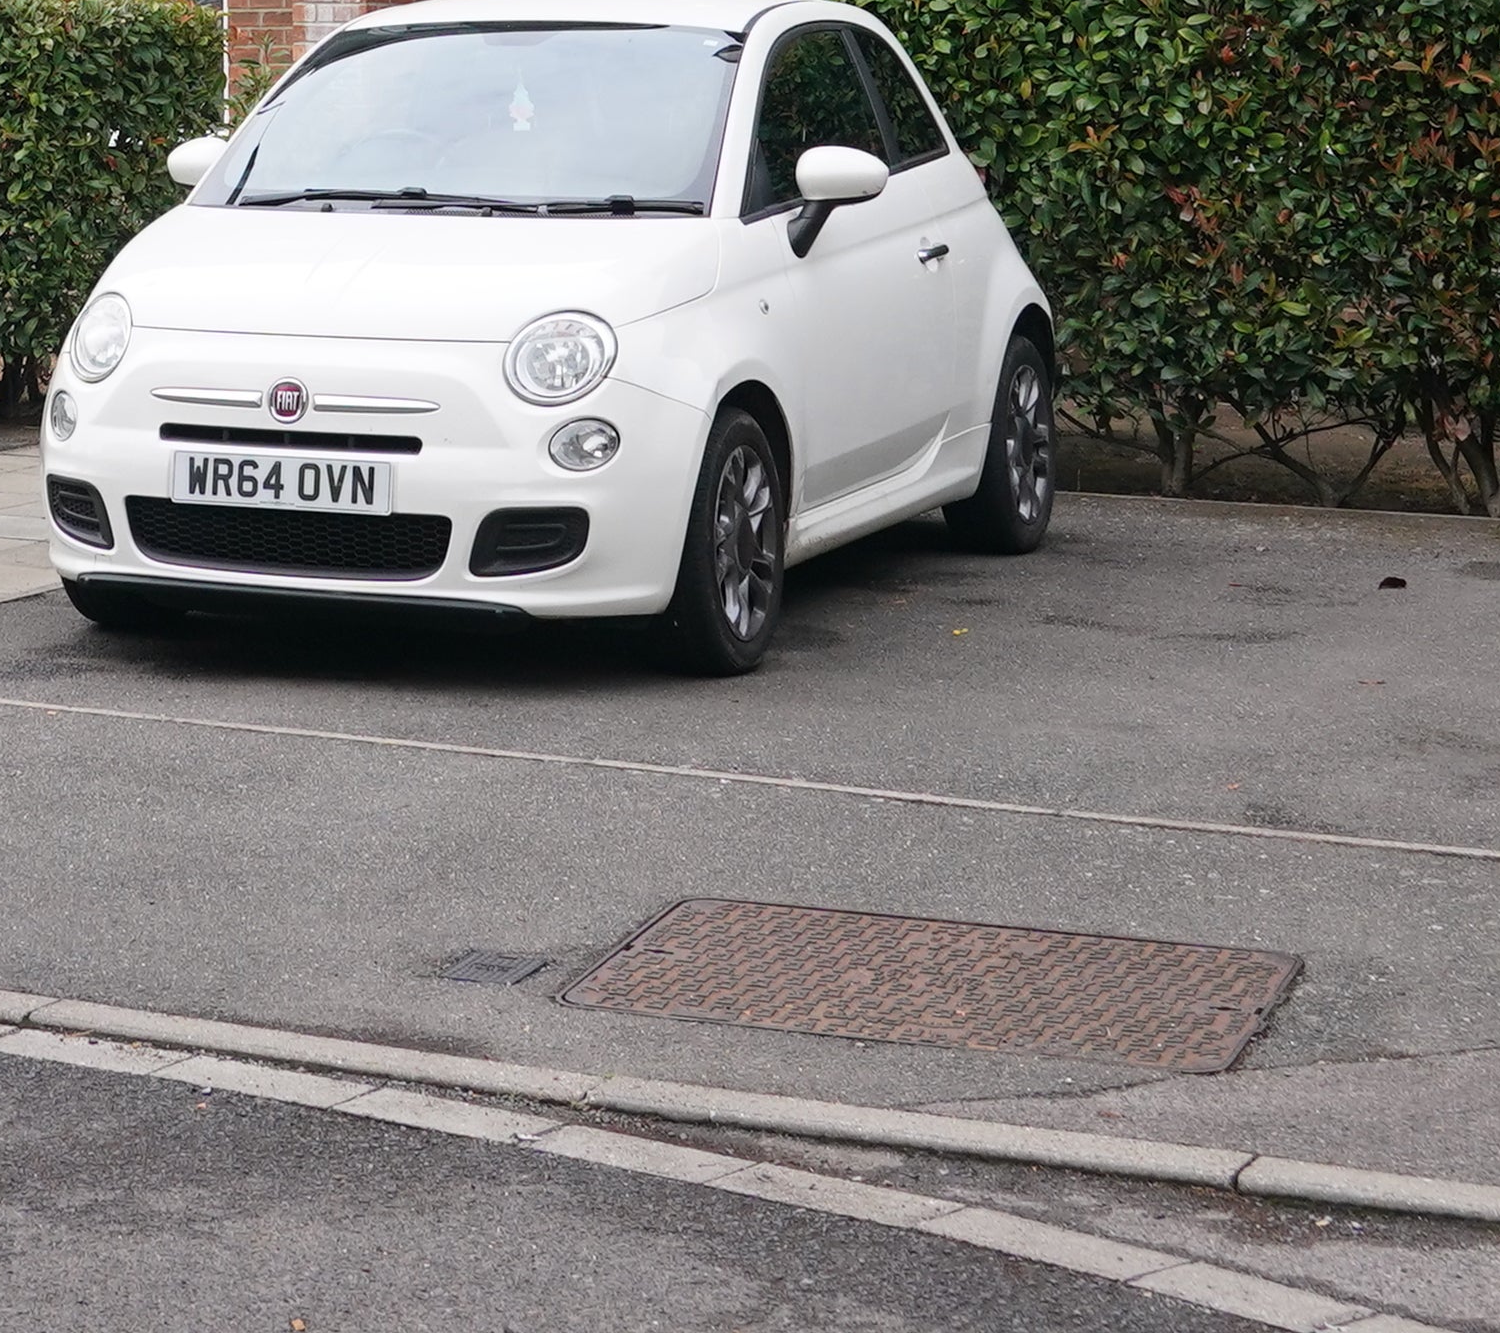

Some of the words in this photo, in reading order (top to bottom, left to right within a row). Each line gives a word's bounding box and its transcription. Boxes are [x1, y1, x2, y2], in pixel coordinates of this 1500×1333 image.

[276, 390, 300, 411] FIAT
[189, 457, 284, 500] WR64
[298, 462, 375, 505] OVN
